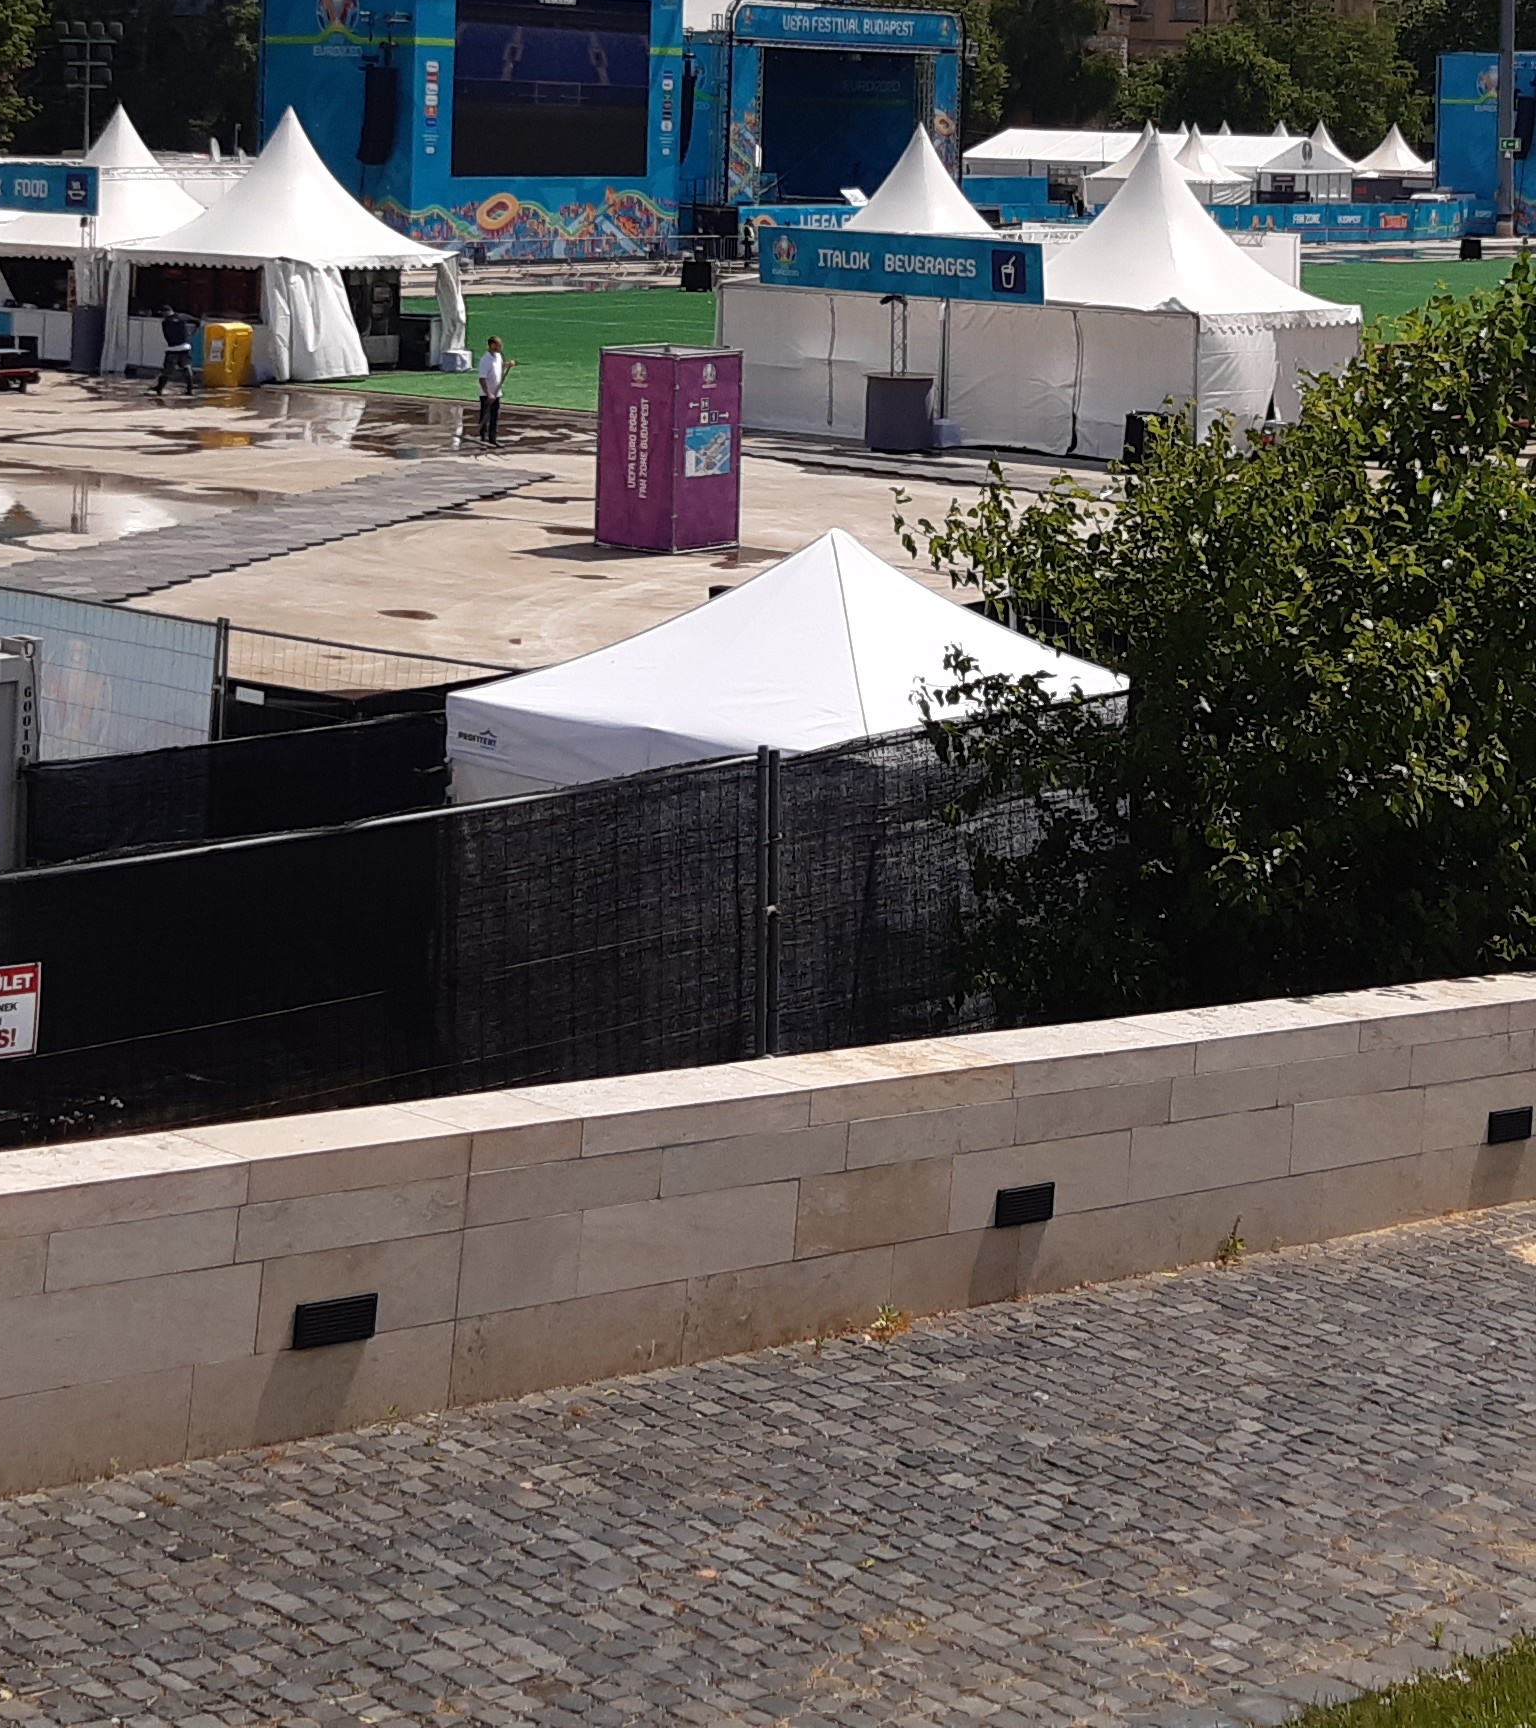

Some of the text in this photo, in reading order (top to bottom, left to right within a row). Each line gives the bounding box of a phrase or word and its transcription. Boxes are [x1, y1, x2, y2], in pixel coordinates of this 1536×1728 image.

[782, 14, 915, 37] UEFA FESTIVAL BUDAPEST
[14, 178, 48, 198] FOOD
[818, 249, 977, 278] ITALOK BEVERAGES
